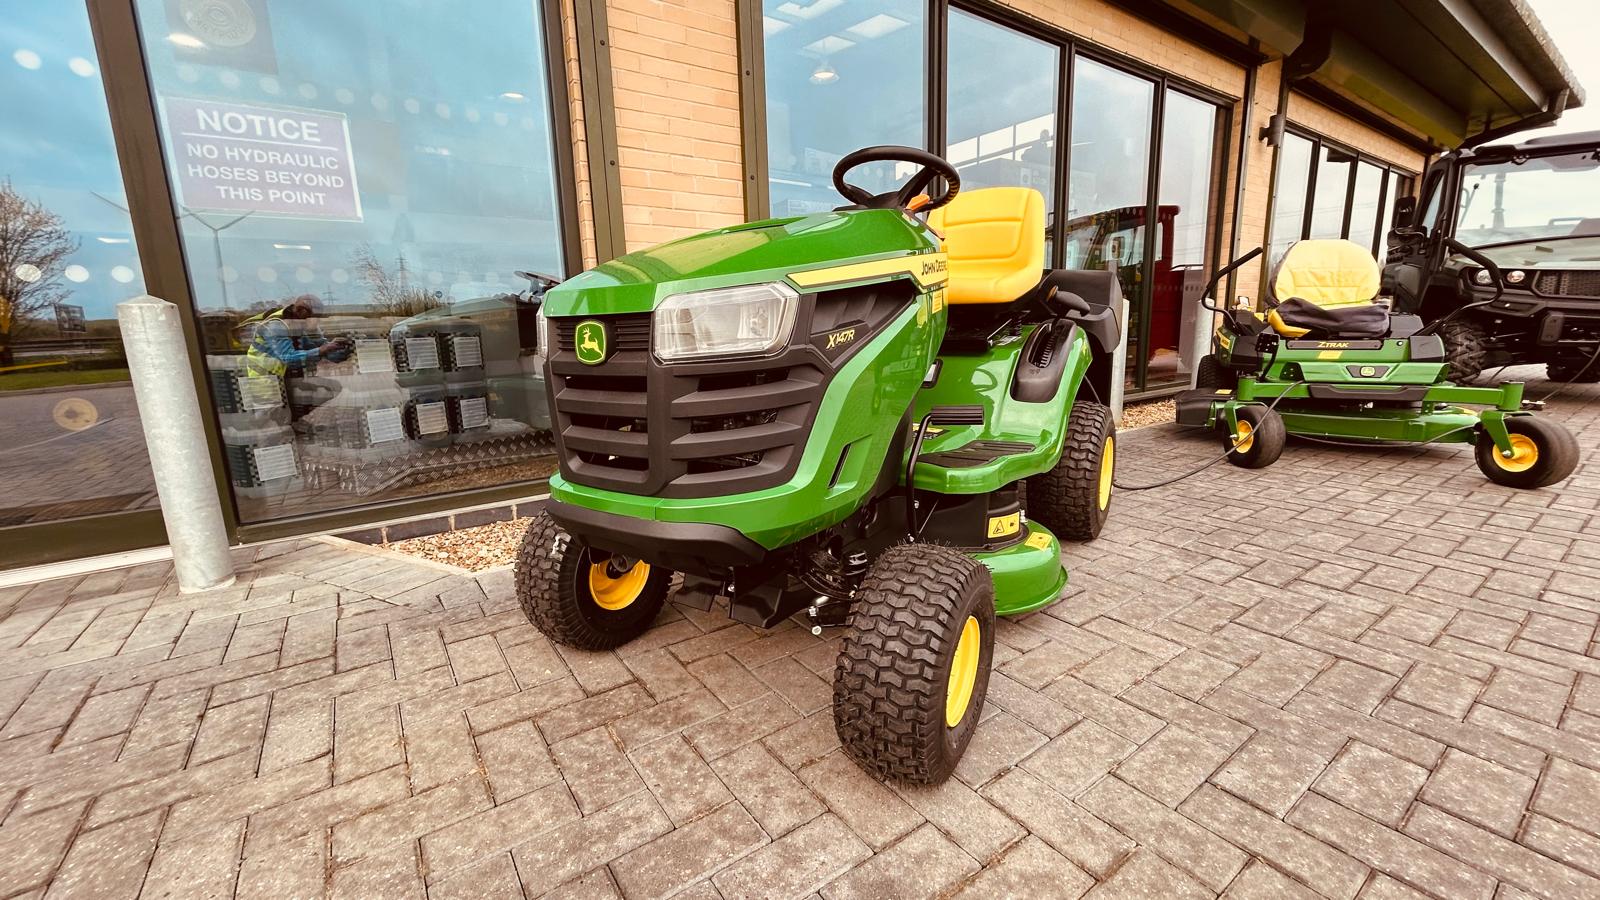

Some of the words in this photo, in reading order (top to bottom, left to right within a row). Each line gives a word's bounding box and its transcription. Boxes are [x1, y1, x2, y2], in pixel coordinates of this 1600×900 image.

[196, 109, 321, 142] NOTICE
[186, 143, 218, 159] NO
[225, 147, 338, 169] HYDRAULIC
[188, 165, 259, 182] HOSES
[264, 170, 344, 188] BEYOND
[216, 185, 263, 201] THIS
[268, 189, 326, 205] POINT
[922, 261, 935, 275] JOHN
[935, 260, 947, 272] DEER
[826, 329, 855, 349] X147R
